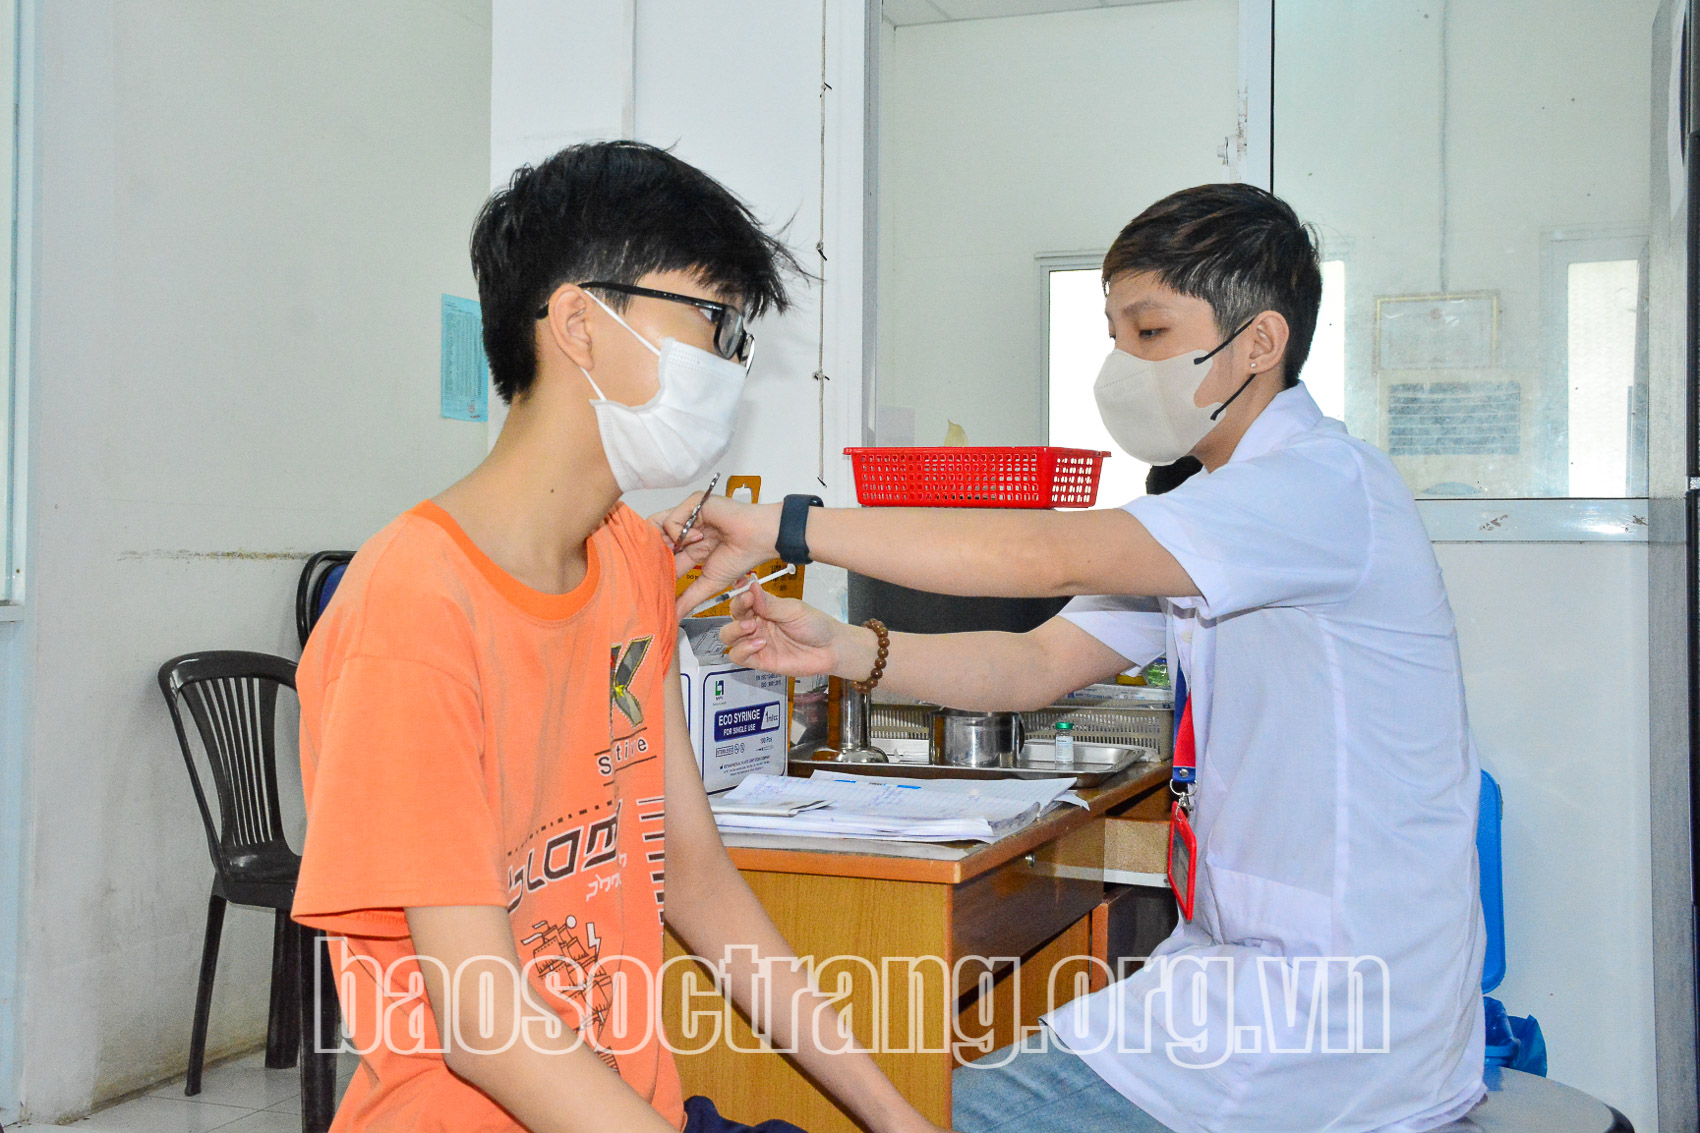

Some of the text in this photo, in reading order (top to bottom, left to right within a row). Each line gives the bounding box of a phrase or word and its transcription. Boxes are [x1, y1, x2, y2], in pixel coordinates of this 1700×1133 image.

[718, 708, 761, 727] ECO SYRINGE
[723, 723, 756, 736] FOR SINGLE USE
